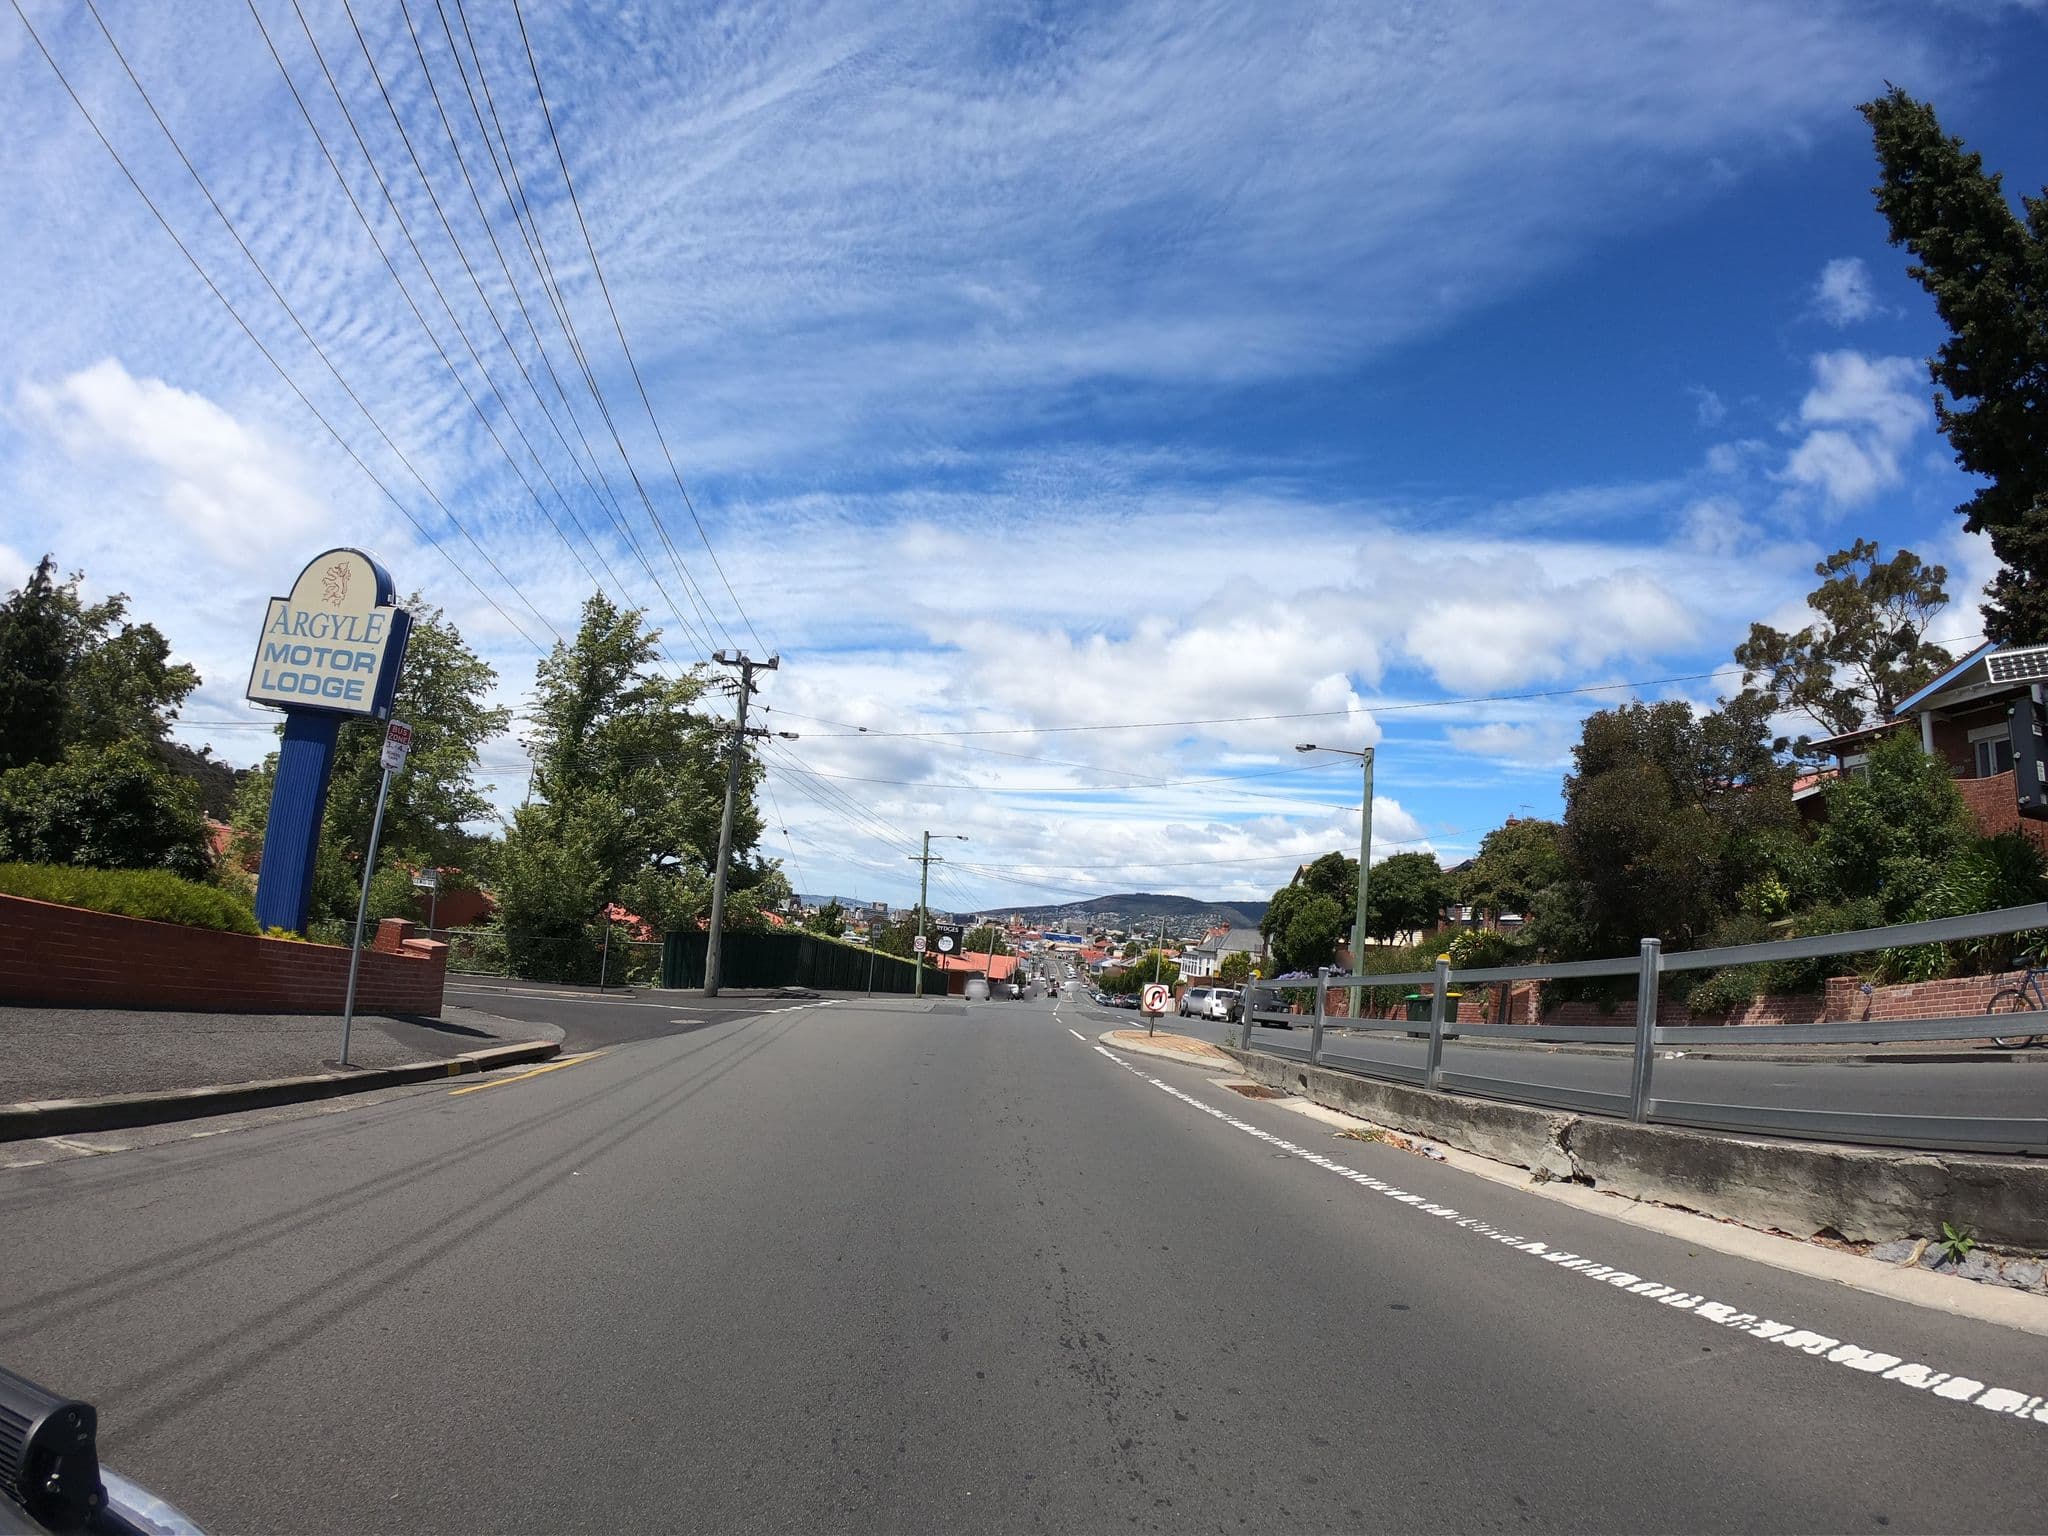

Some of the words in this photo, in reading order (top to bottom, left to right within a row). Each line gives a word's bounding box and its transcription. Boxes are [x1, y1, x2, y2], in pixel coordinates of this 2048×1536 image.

[268, 605, 386, 644] ARGYLE
[263, 642, 377, 674] MOTOR
[261, 669, 365, 701] LODGE
[388, 732, 408, 745] ZONE
[392, 725, 409, 736] BUS
